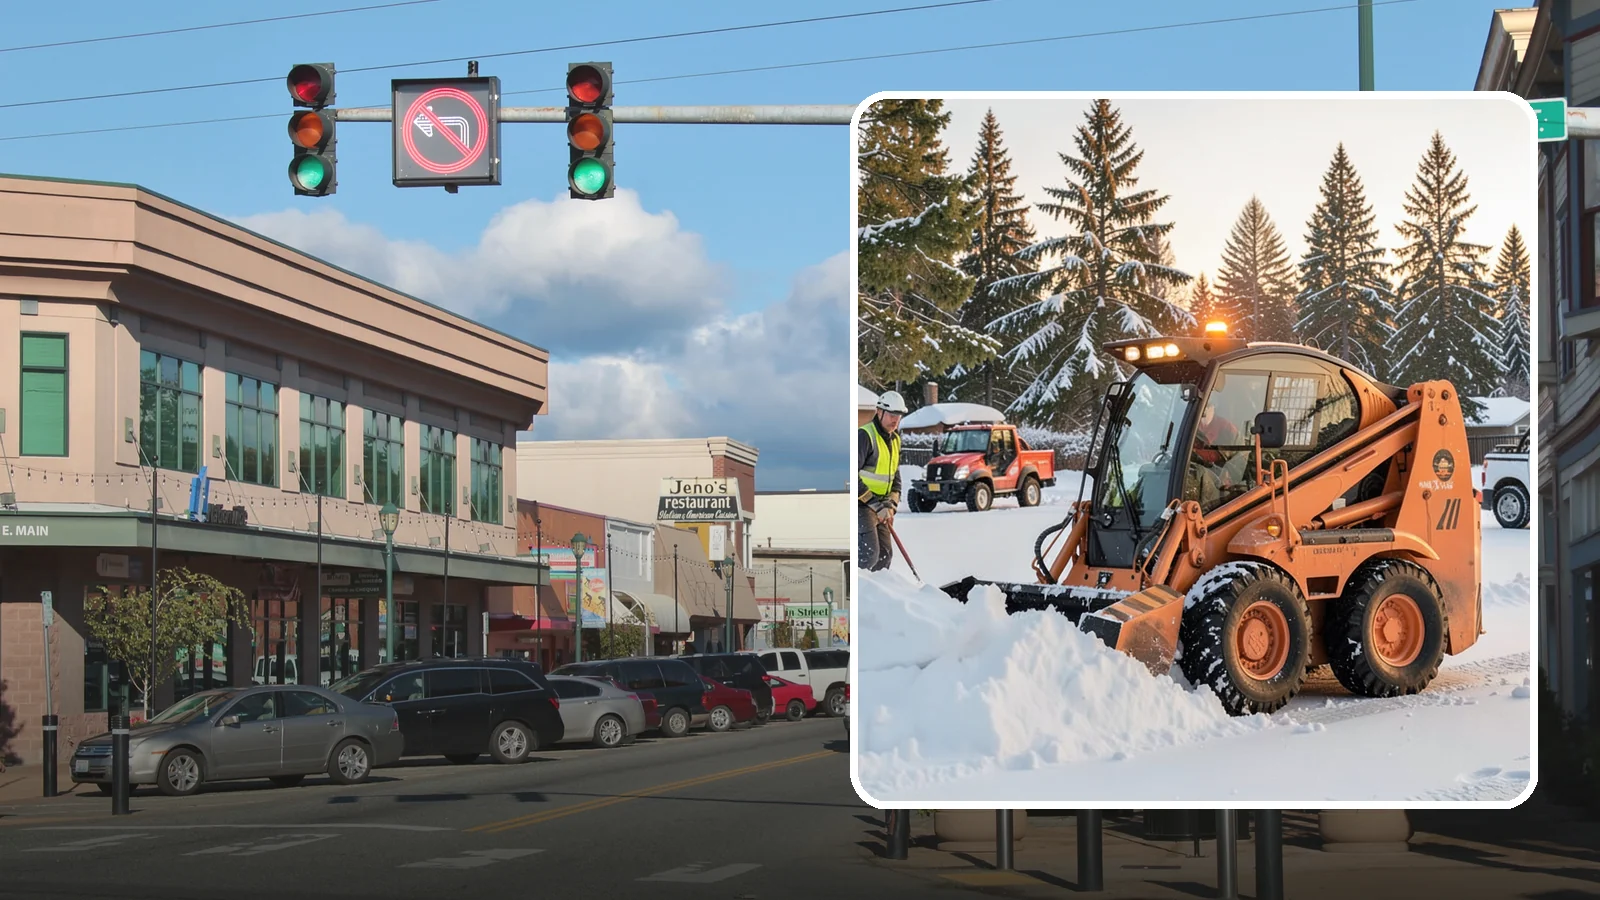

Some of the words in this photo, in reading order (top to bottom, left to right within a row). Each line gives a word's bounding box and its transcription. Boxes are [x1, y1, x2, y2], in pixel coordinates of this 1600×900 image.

[670, 480, 727, 494] Jeno's
[665, 496, 731, 509] restaurant
[686, 509, 714, 519] American
[715, 509, 737, 519] Cuisine
[2, 525, 13, 536] E.
[15, 525, 49, 536] MAIN
[797, 607, 828, 616] Street
